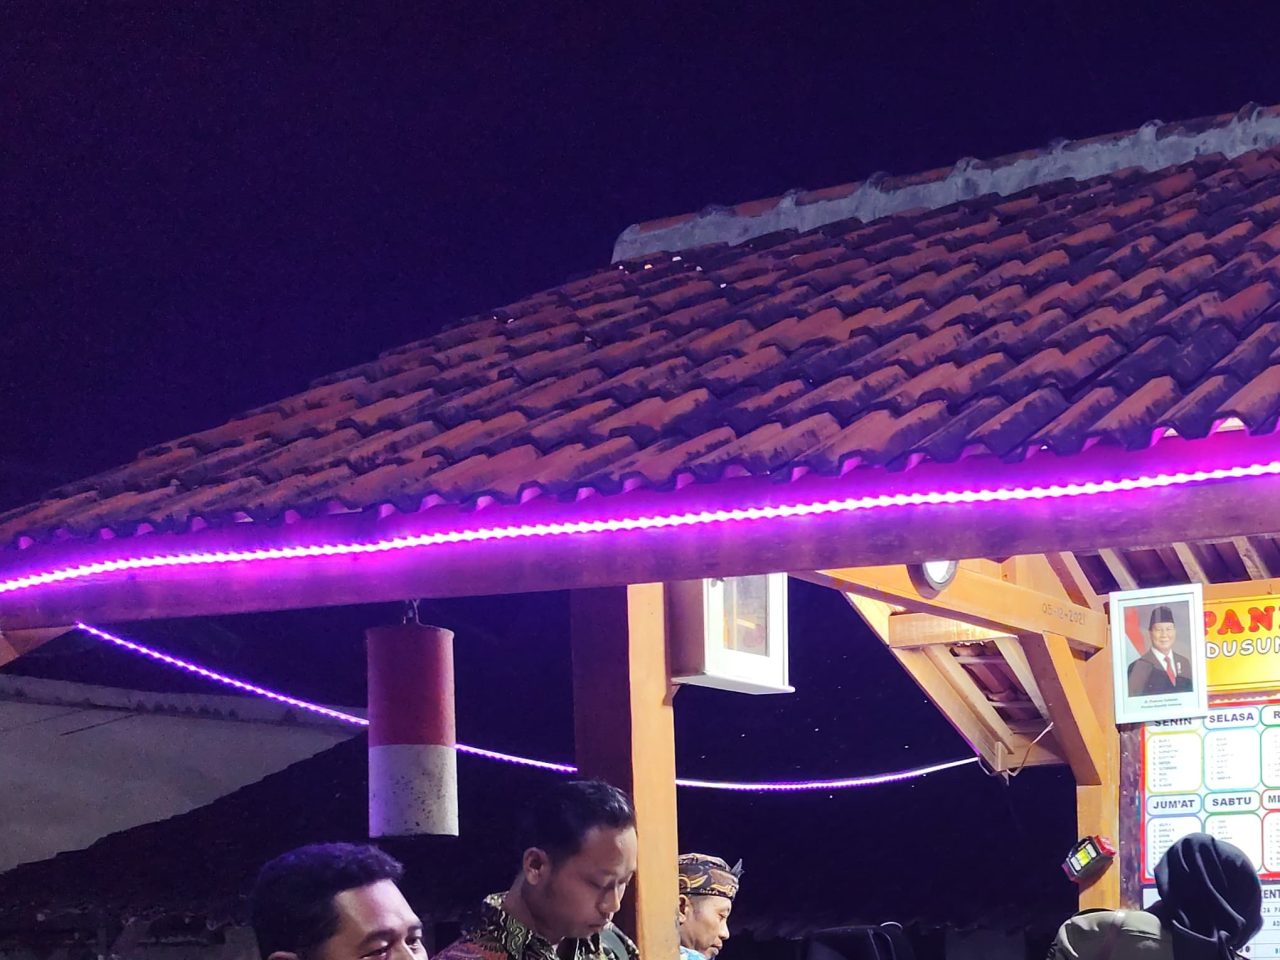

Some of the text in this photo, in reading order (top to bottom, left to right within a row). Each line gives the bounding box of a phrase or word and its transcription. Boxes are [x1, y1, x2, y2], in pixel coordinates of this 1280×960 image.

[1209, 712, 1254, 723] SELASA
[1153, 799, 1195, 809] JUM'AT
[1212, 797, 1252, 807] SABTU
